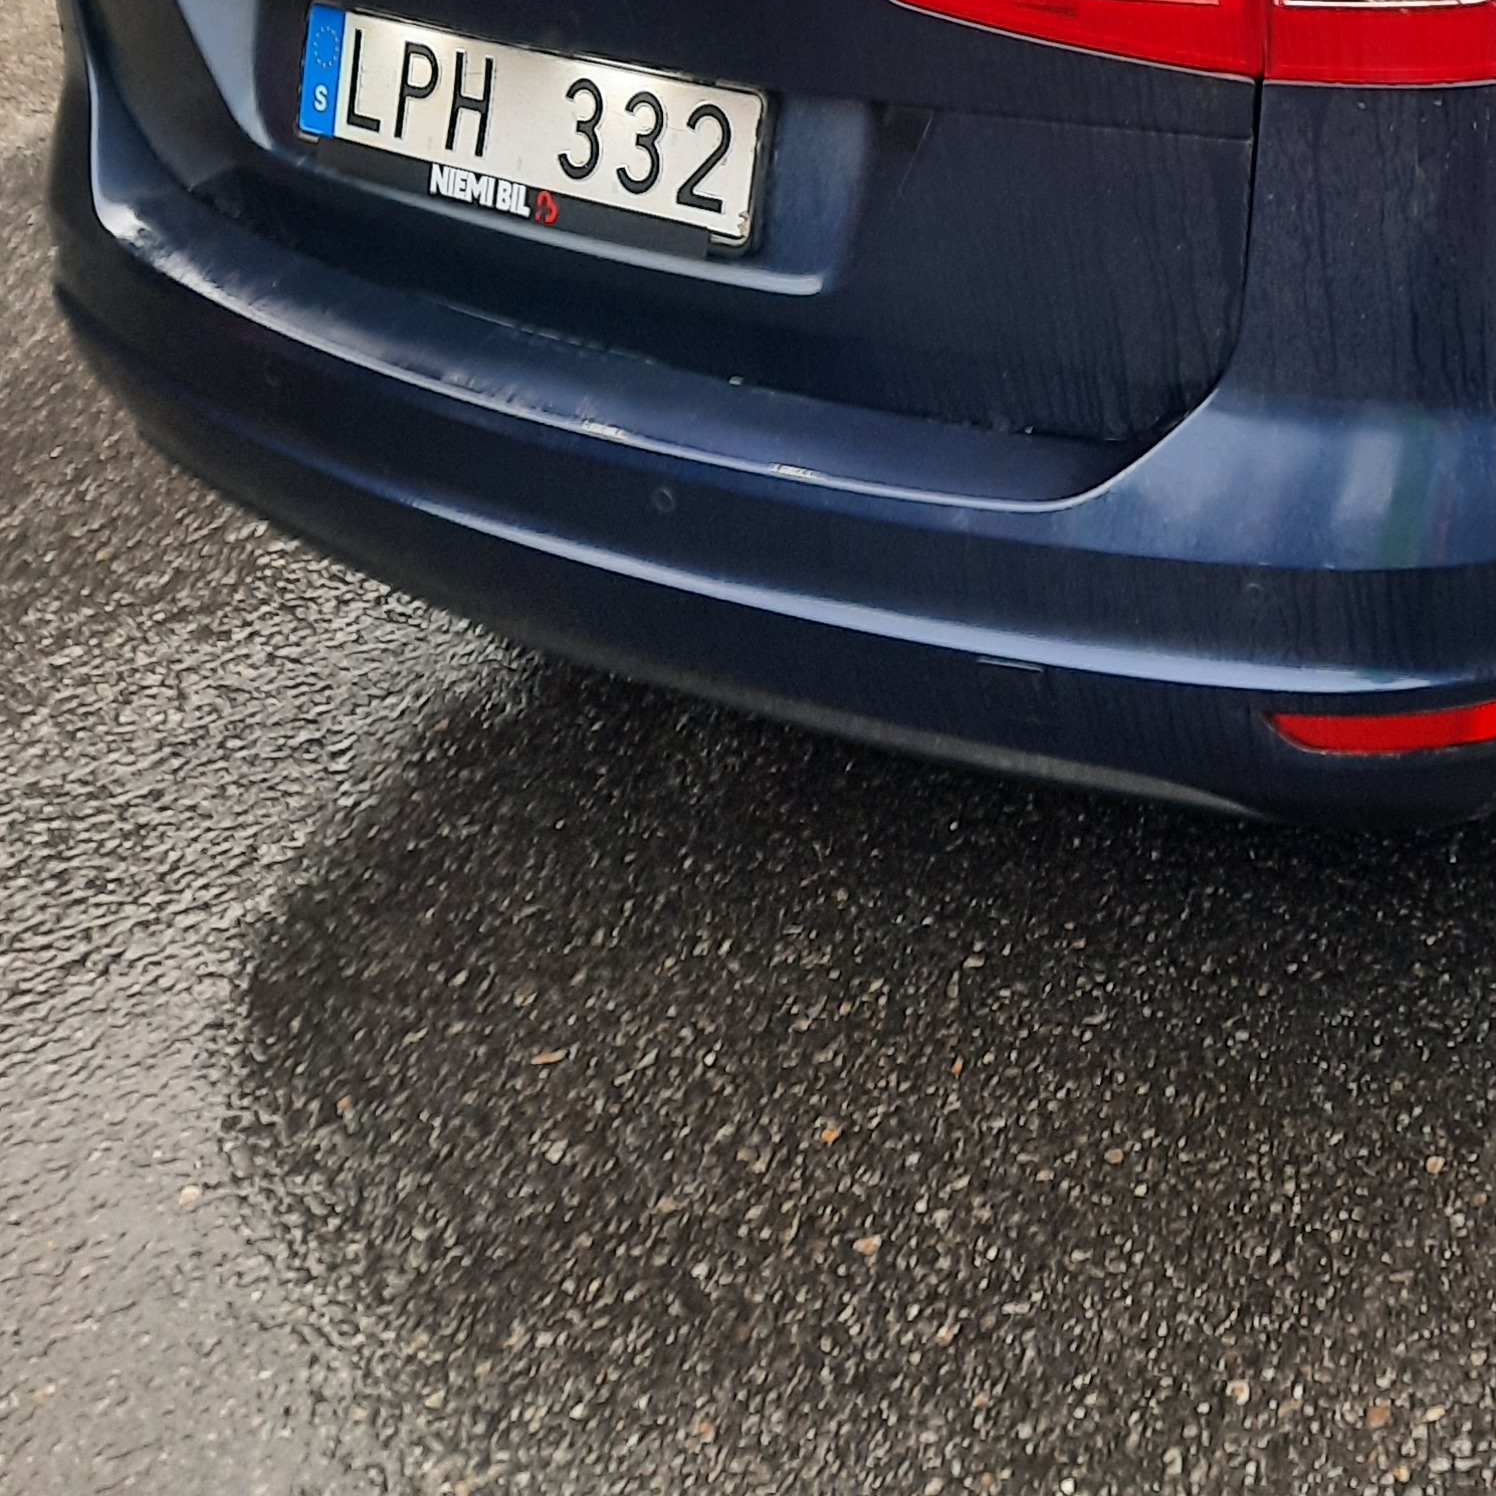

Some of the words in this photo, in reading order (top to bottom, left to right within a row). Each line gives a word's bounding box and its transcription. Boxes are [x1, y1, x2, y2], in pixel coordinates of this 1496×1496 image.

[314, 84, 329, 111] S
[346, 28, 495, 157] LPH
[557, 78, 732, 213] 332
[429, 163, 495, 208] NIEMI
[496, 178, 531, 218] BIL
